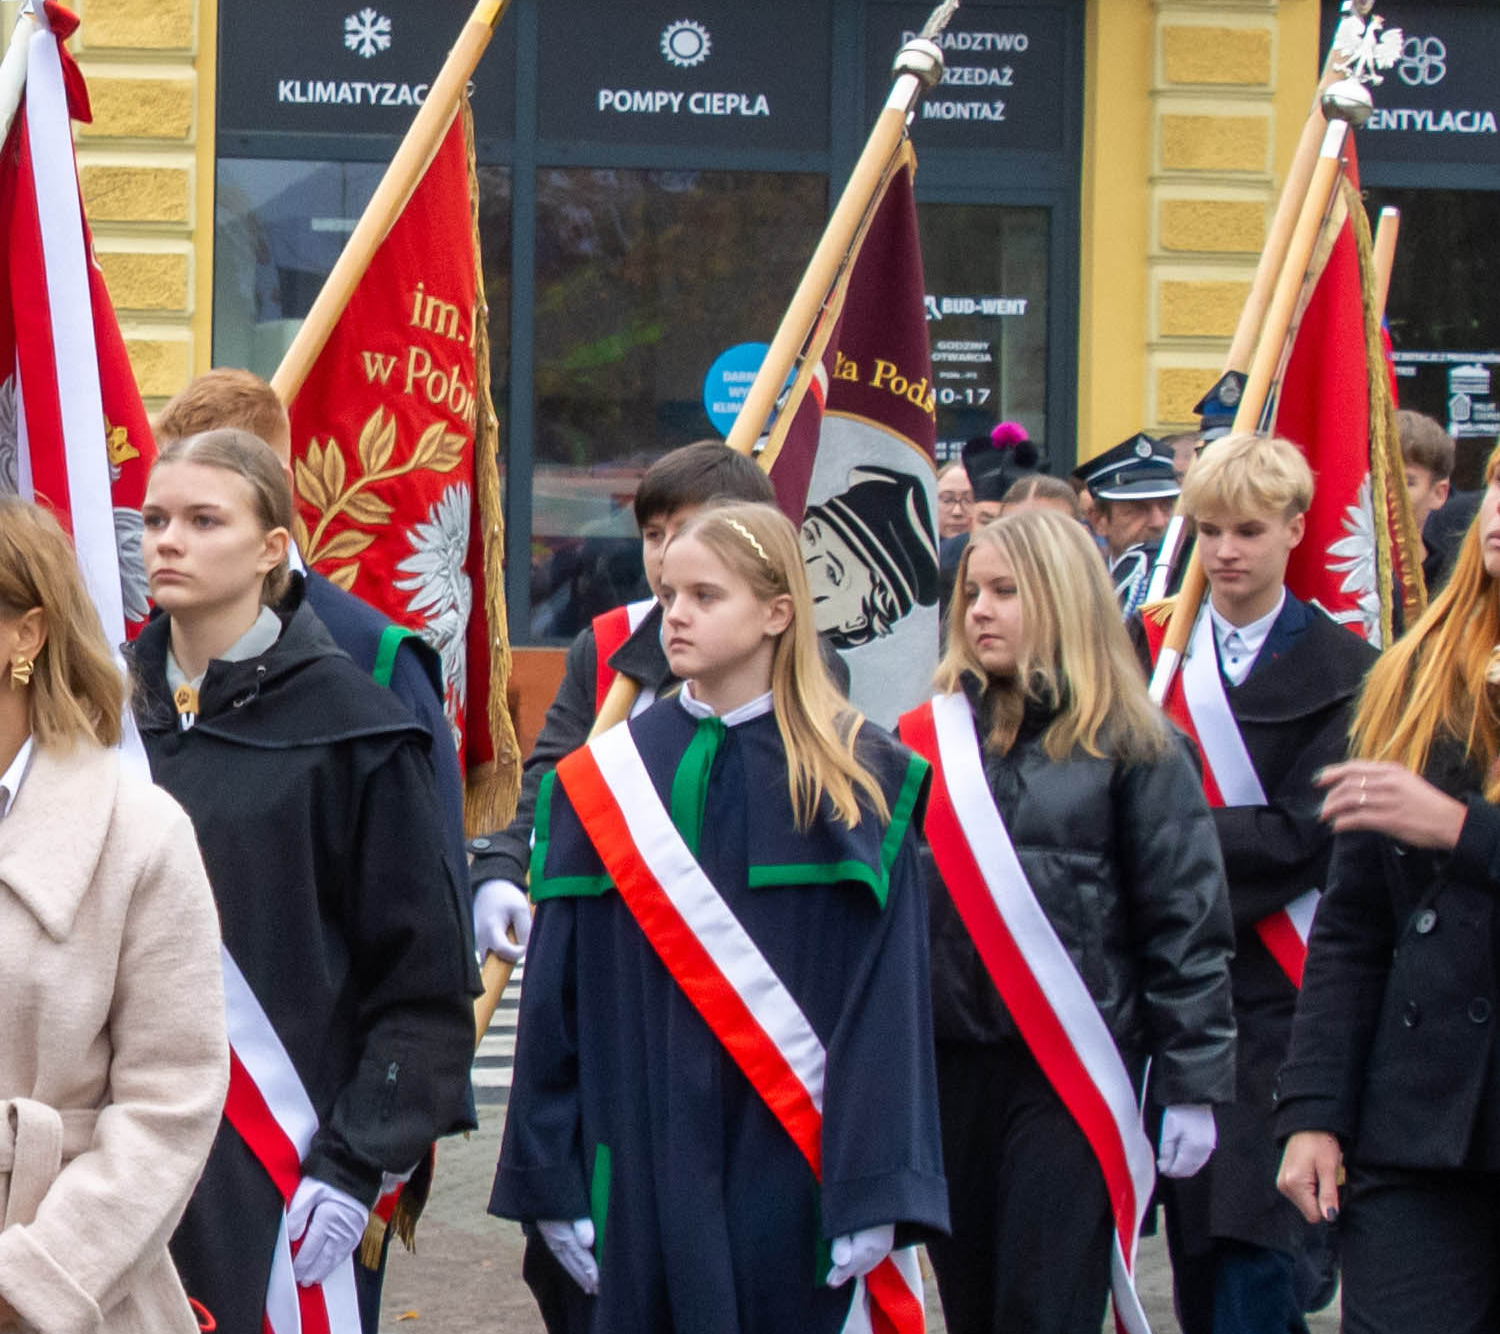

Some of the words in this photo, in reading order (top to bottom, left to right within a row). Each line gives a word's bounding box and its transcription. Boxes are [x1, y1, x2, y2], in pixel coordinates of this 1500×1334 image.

[939, 66, 1014, 86] RZEDAŻ
[278, 80, 429, 106] KLIMATYZAC
[599, 88, 685, 113] POMPY
[688, 92, 770, 116] CIEPŁA
[923, 100, 1007, 121] MONTAŻ
[1361, 109, 1498, 133] ENTYLACJA
[410, 281, 466, 343] im.
[940, 298, 1028, 316] BUD-WENT
[937, 340, 990, 351] GODZINY
[361, 350, 398, 386] w
[931, 352, 992, 363] OTWARCIA
